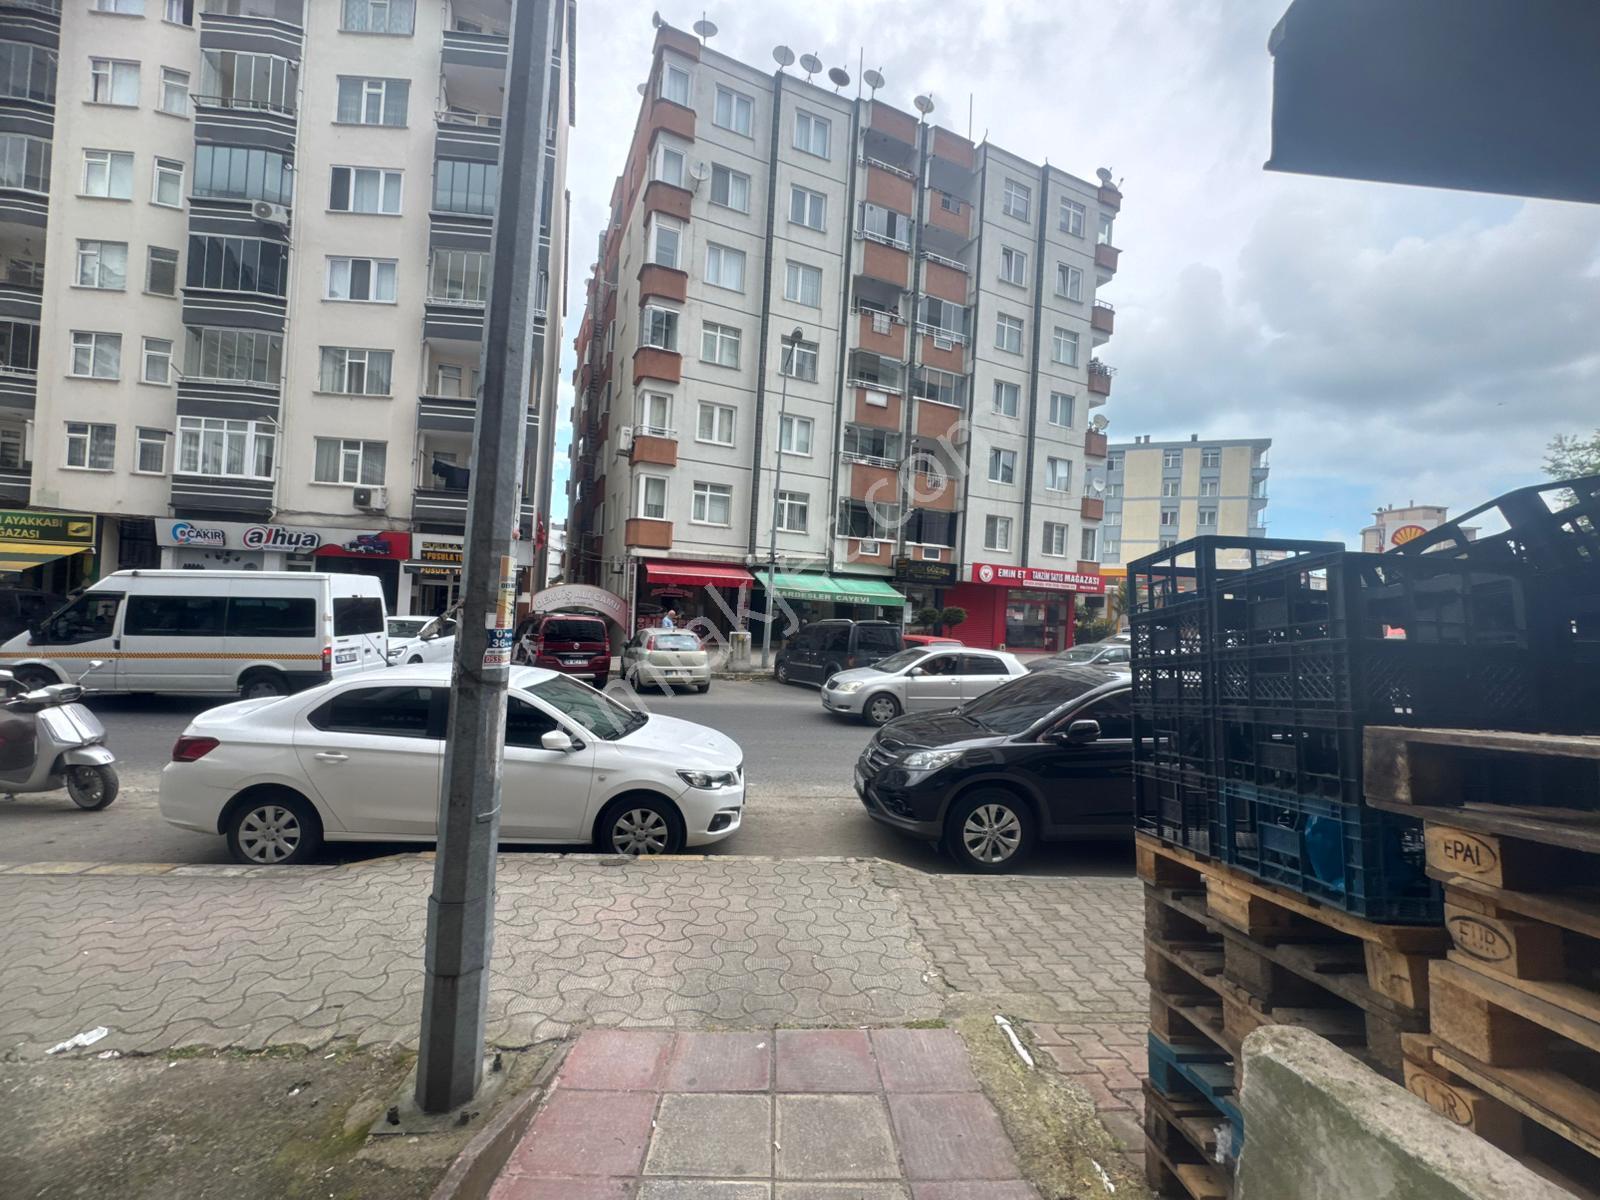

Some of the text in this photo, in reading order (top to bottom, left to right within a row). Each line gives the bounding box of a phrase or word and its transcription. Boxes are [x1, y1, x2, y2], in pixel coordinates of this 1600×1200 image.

[4, 515, 63, 527] AYAKKABI
[420, 567, 450, 575] PUSULA
[1064, 573, 1100, 585] MAĞAZASI
